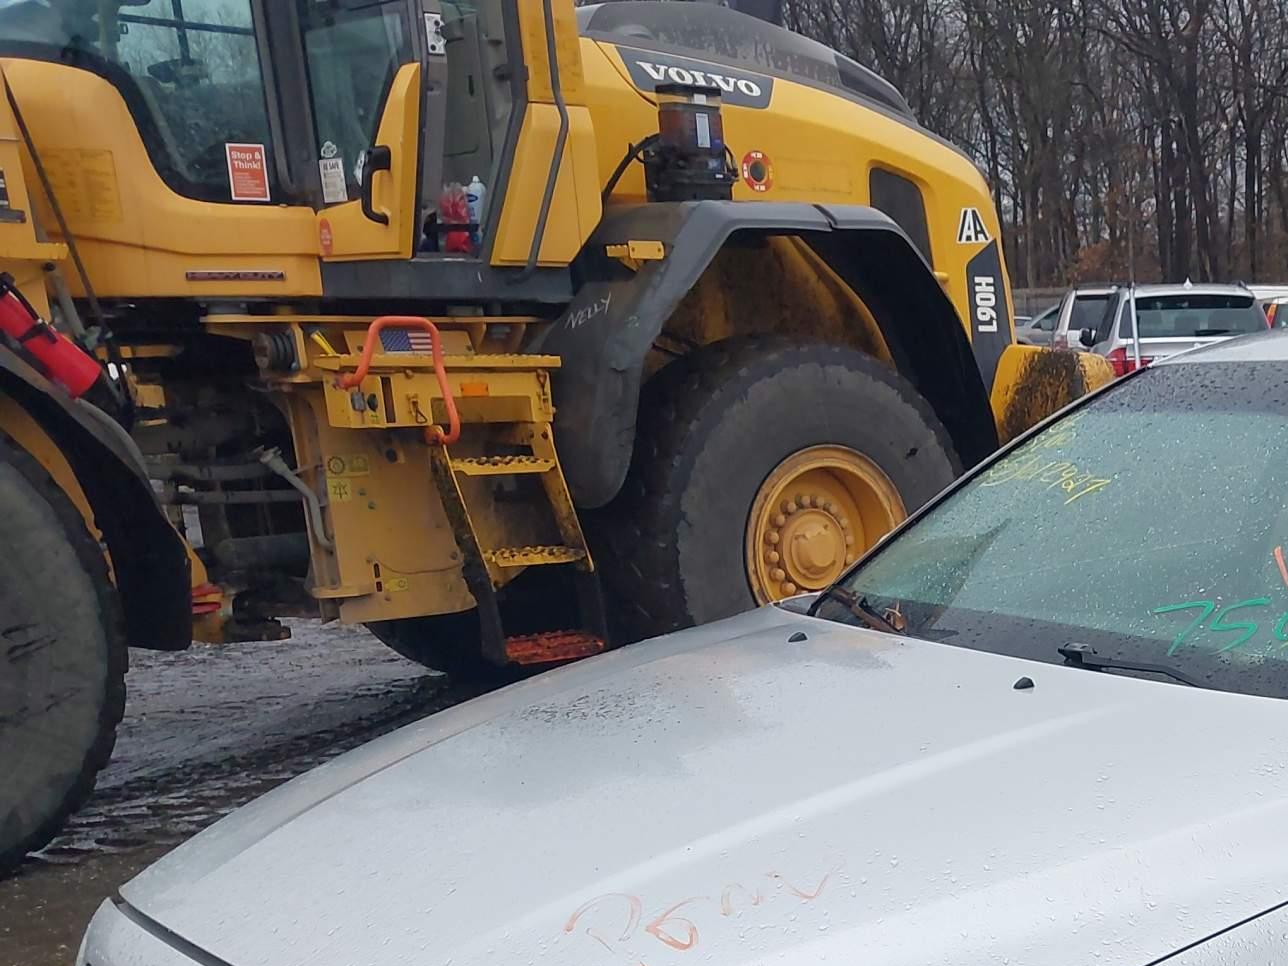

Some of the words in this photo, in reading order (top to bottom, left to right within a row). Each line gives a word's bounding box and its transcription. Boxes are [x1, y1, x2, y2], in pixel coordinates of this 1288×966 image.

[635, 60, 762, 97] VOLVO
[231, 150, 252, 160] Stop
[254, 151, 262, 159] &
[234, 160, 261, 169] Think!
[973, 276, 998, 333] L90H
